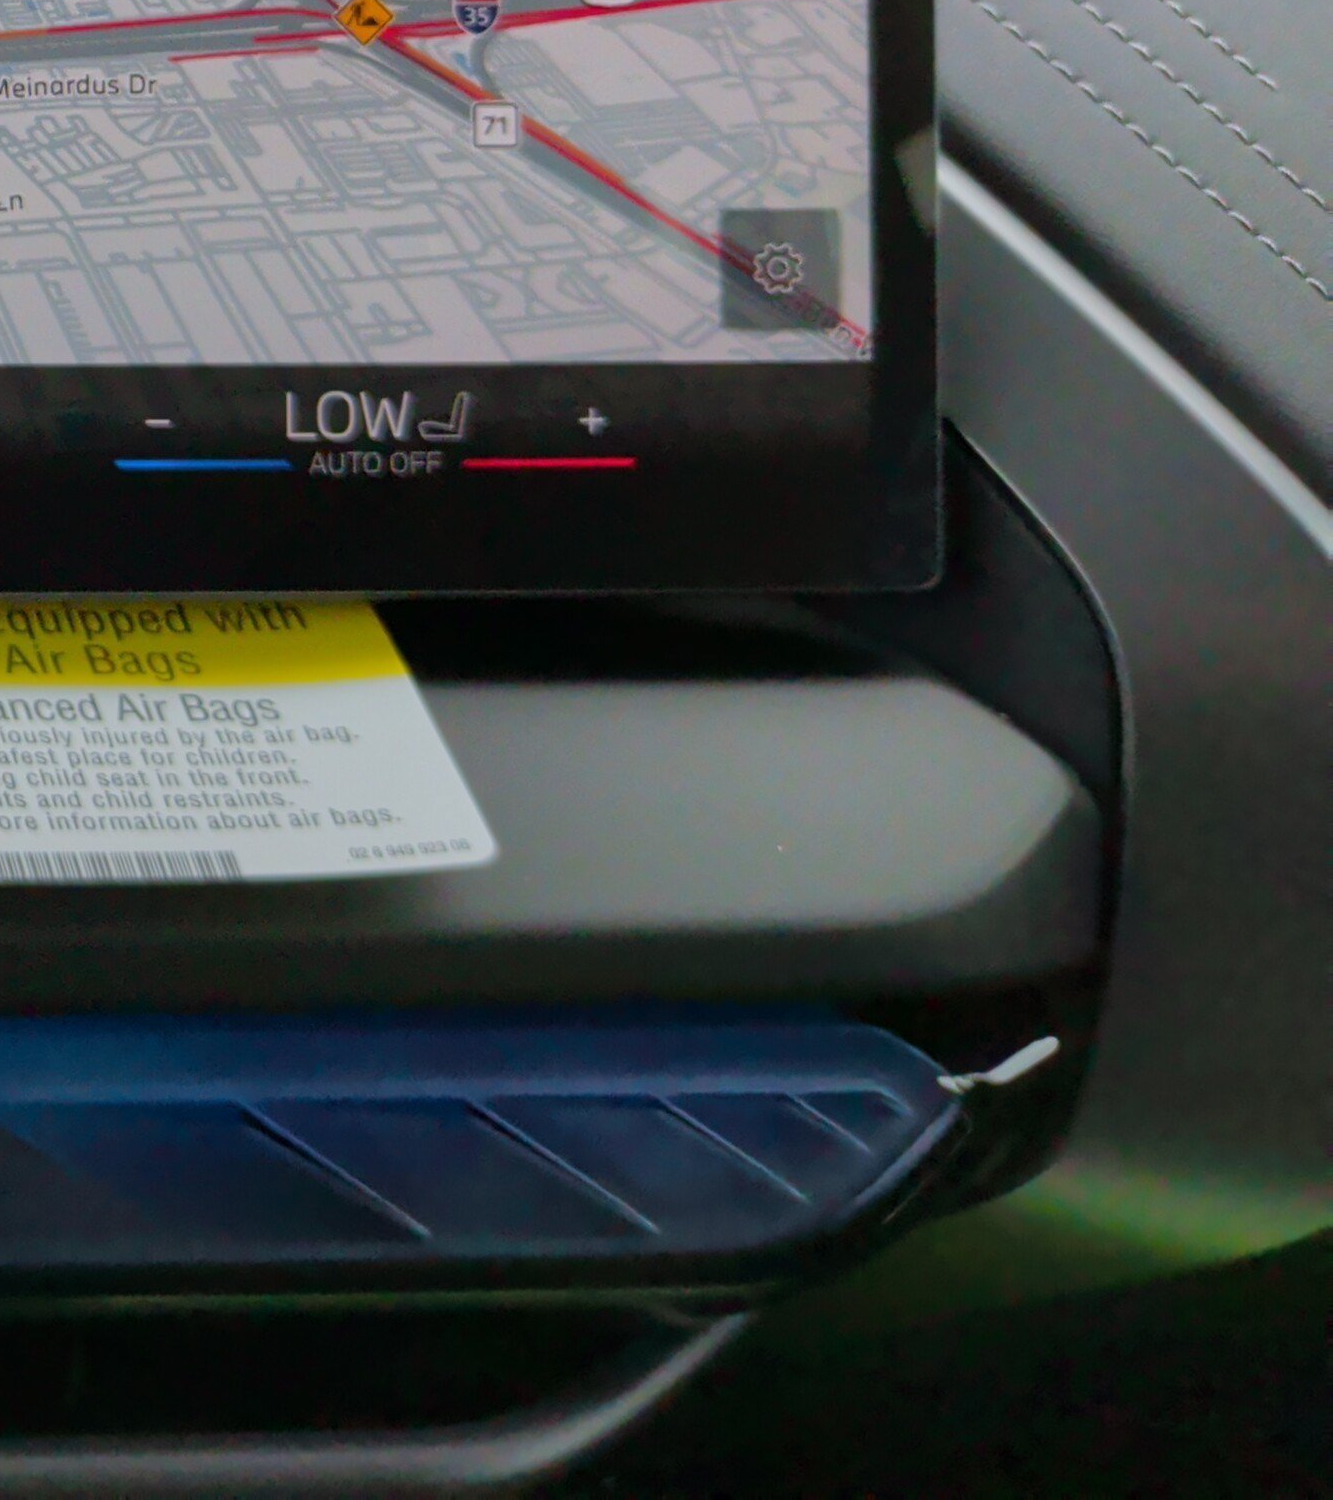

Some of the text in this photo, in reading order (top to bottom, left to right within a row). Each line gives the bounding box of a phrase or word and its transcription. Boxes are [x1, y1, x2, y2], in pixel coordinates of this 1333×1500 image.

[464, 6, 489, 25] 35
[128, 74, 156, 94] Dr
[483, 115, 508, 134] 71
[284, 391, 413, 442] LOW
[308, 450, 442, 477] AUTO OFF
[203, 601, 309, 633] with
[6, 642, 67, 675] Air
[84, 642, 202, 682] Bags
[116, 693, 167, 722] Air
[180, 693, 281, 727] Bags
[81, 728, 169, 749] injured
[179, 729, 208, 749] by
[216, 728, 254, 745] the
[265, 726, 295, 744] air
[68, 749, 131, 769] place
[141, 748, 175, 766] for
[185, 747, 297, 765] children.
[25, 769, 87, 787] child
[97, 771, 148, 787] seat
[157, 769, 180, 787] in
[188, 769, 229, 786] the
[37, 791, 84, 808] and
[92, 790, 152, 808] child
[163, 790, 294, 808] restraints.
[49, 811, 199, 831] information
[207, 810, 281, 829] about
[288, 809, 320, 828] air
[331, 806, 401, 829] bags.
